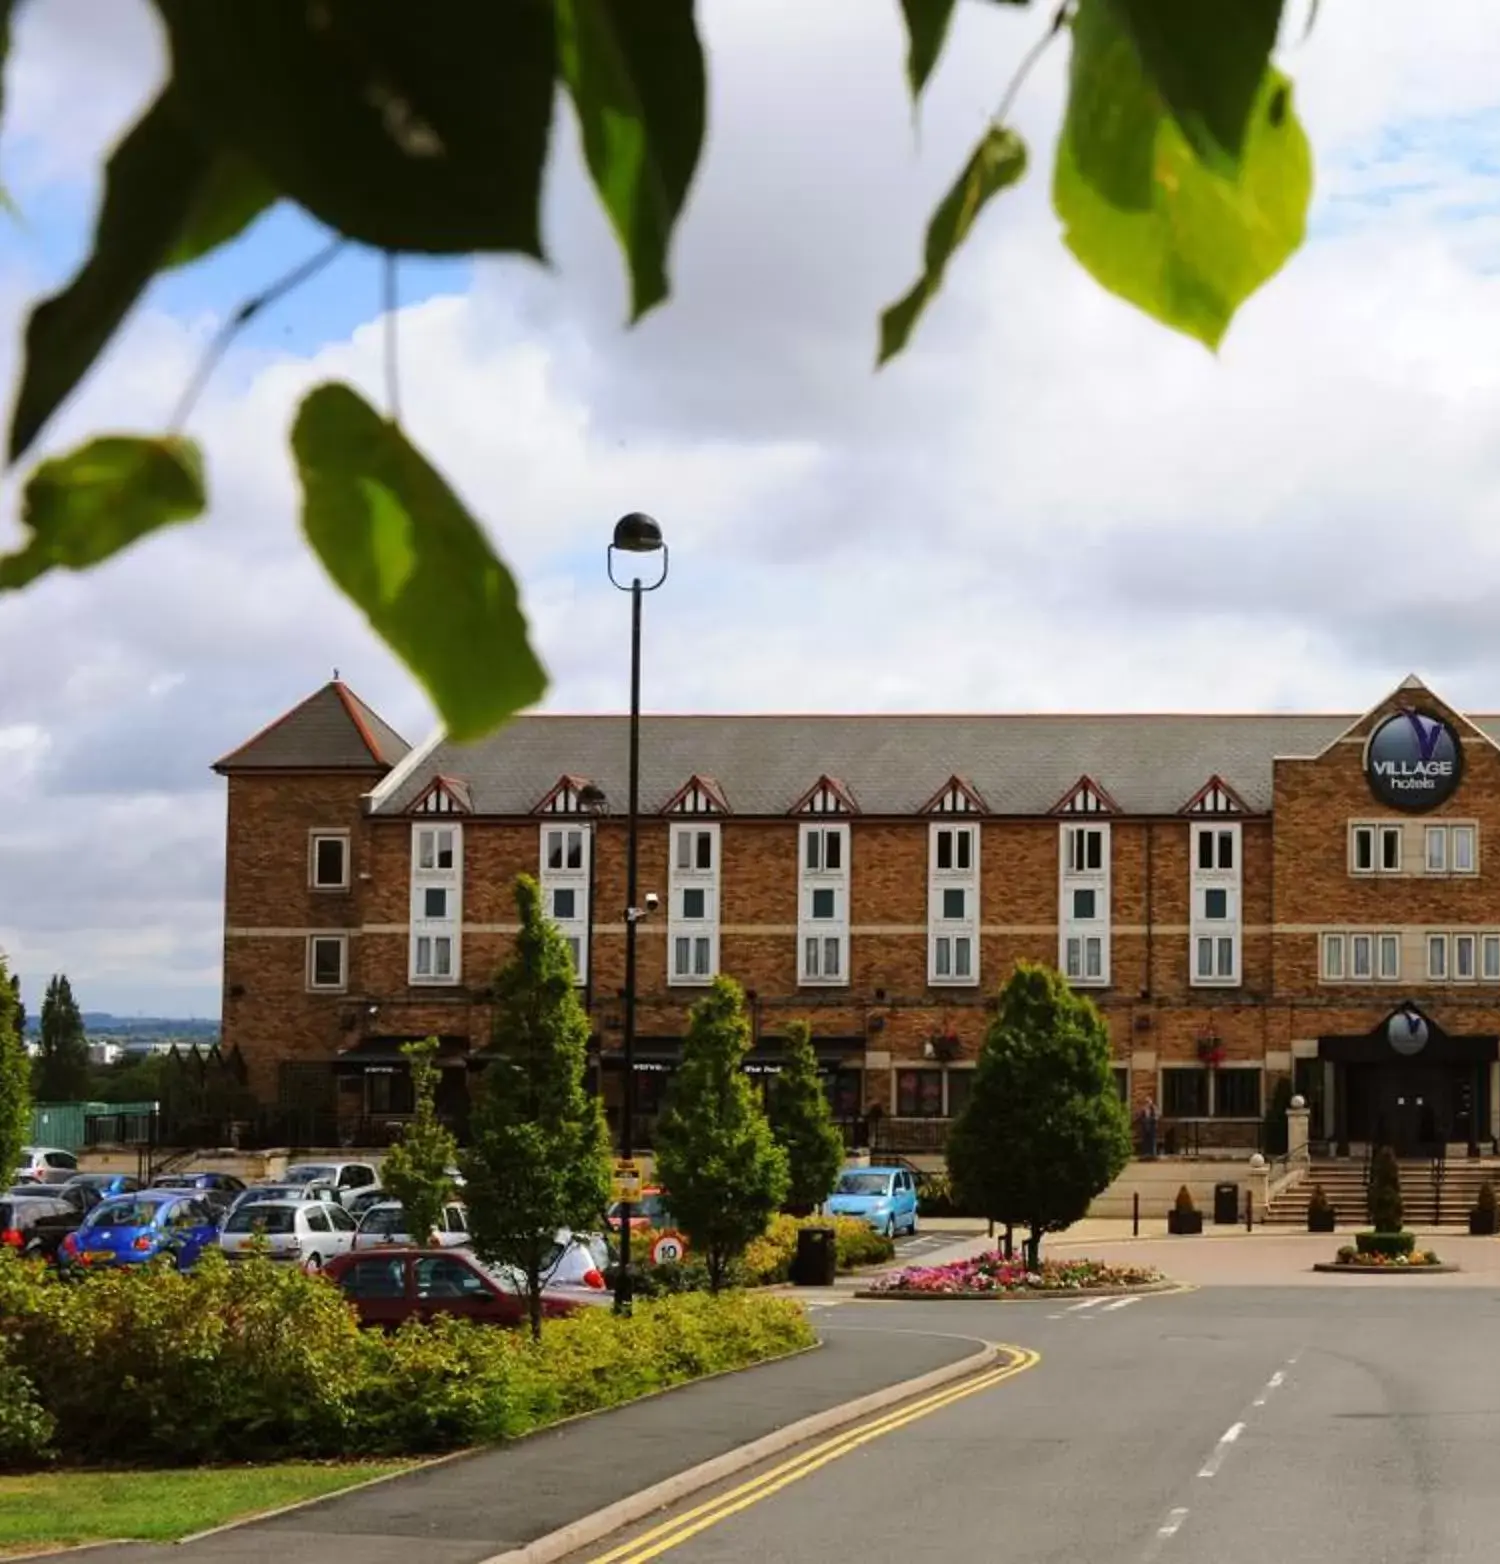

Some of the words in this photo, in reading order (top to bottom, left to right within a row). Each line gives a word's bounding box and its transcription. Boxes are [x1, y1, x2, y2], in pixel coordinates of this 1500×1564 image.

[1373, 760, 1453, 776] VILLAGE
[1391, 776, 1436, 790] hotels
[661, 1245, 678, 1260] 10
